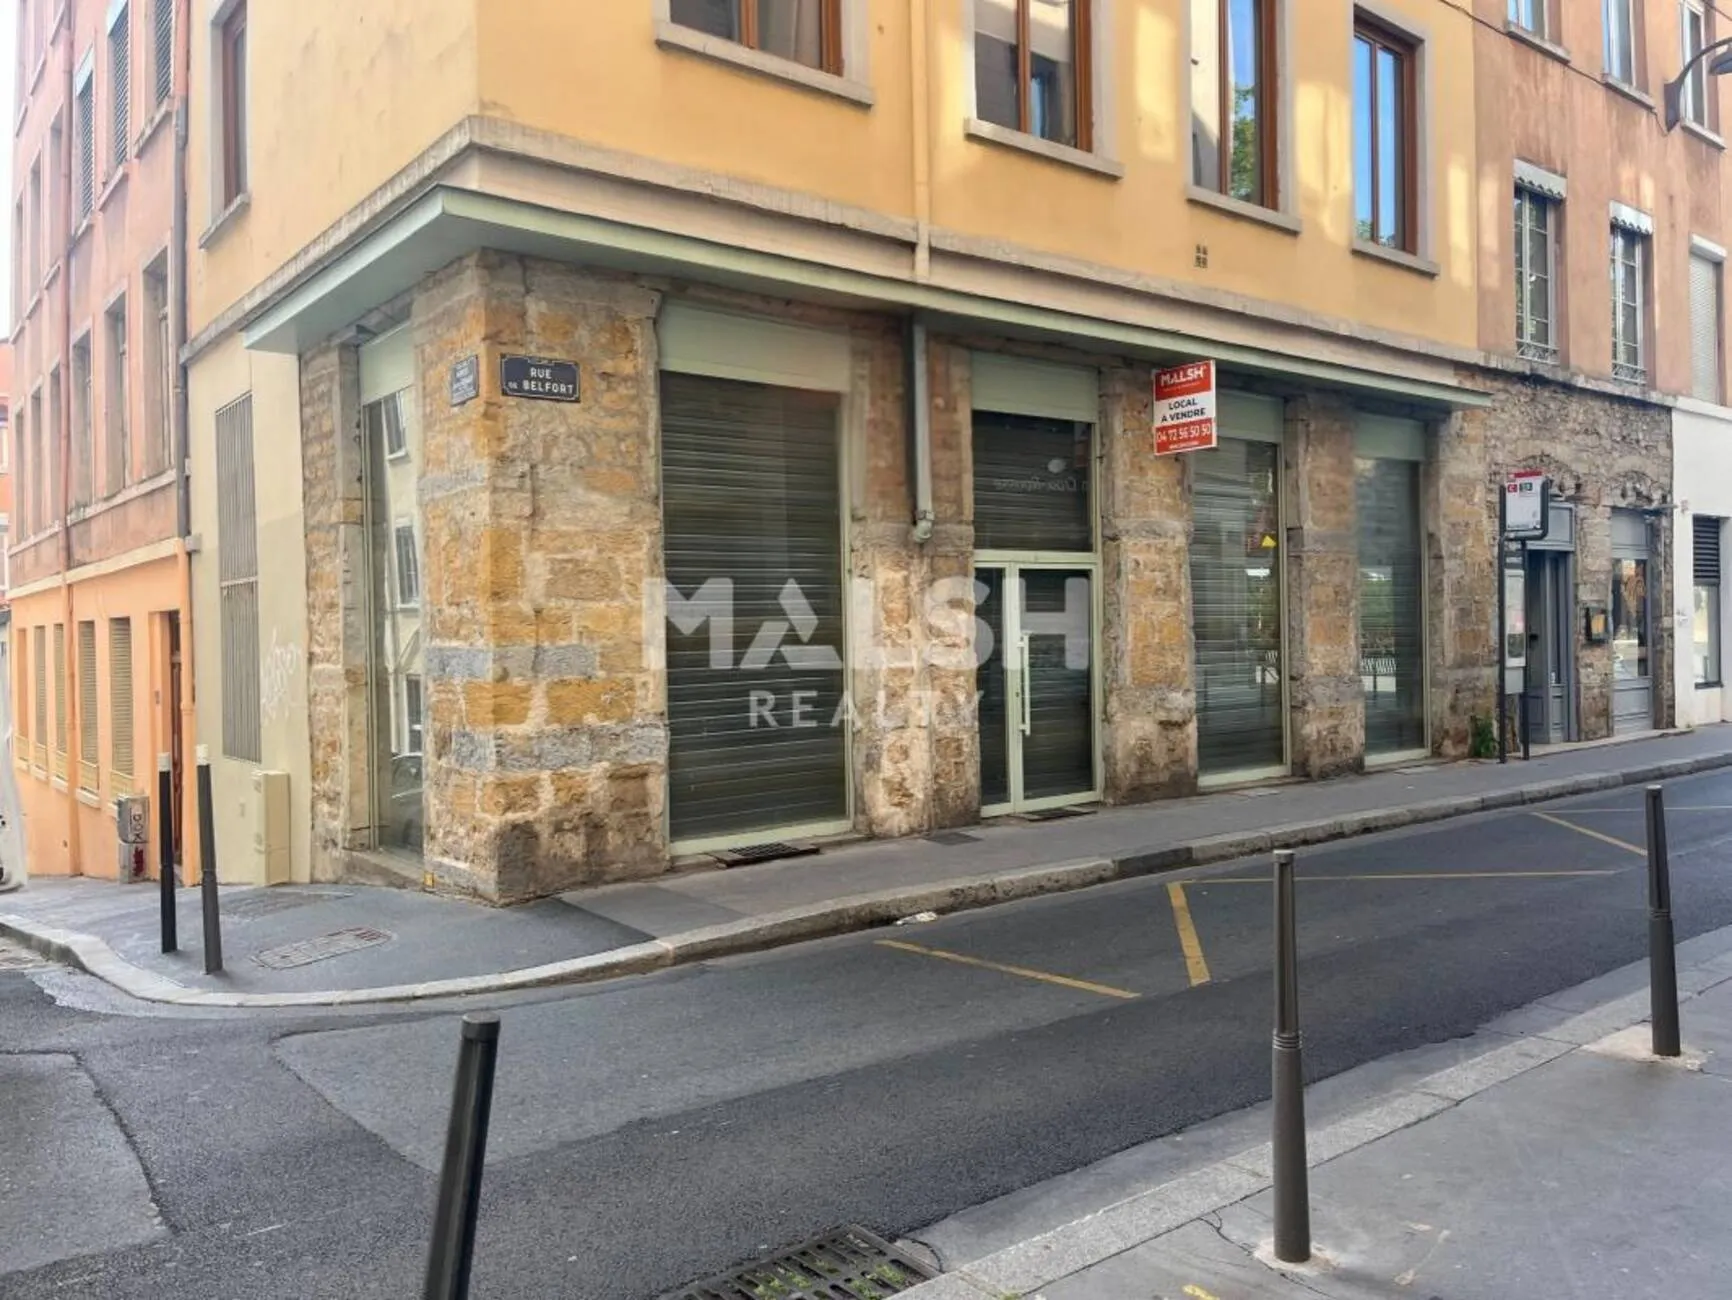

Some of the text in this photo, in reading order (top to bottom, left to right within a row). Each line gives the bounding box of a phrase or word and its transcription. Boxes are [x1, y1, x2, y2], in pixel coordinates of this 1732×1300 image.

[530, 367, 552, 379] RUE
[1161, 366, 1204, 386] MALSH
[522, 380, 574, 394] BELFORT
[1168, 398, 1198, 411] LOCAL
[1169, 408, 1206, 421] VENDRE
